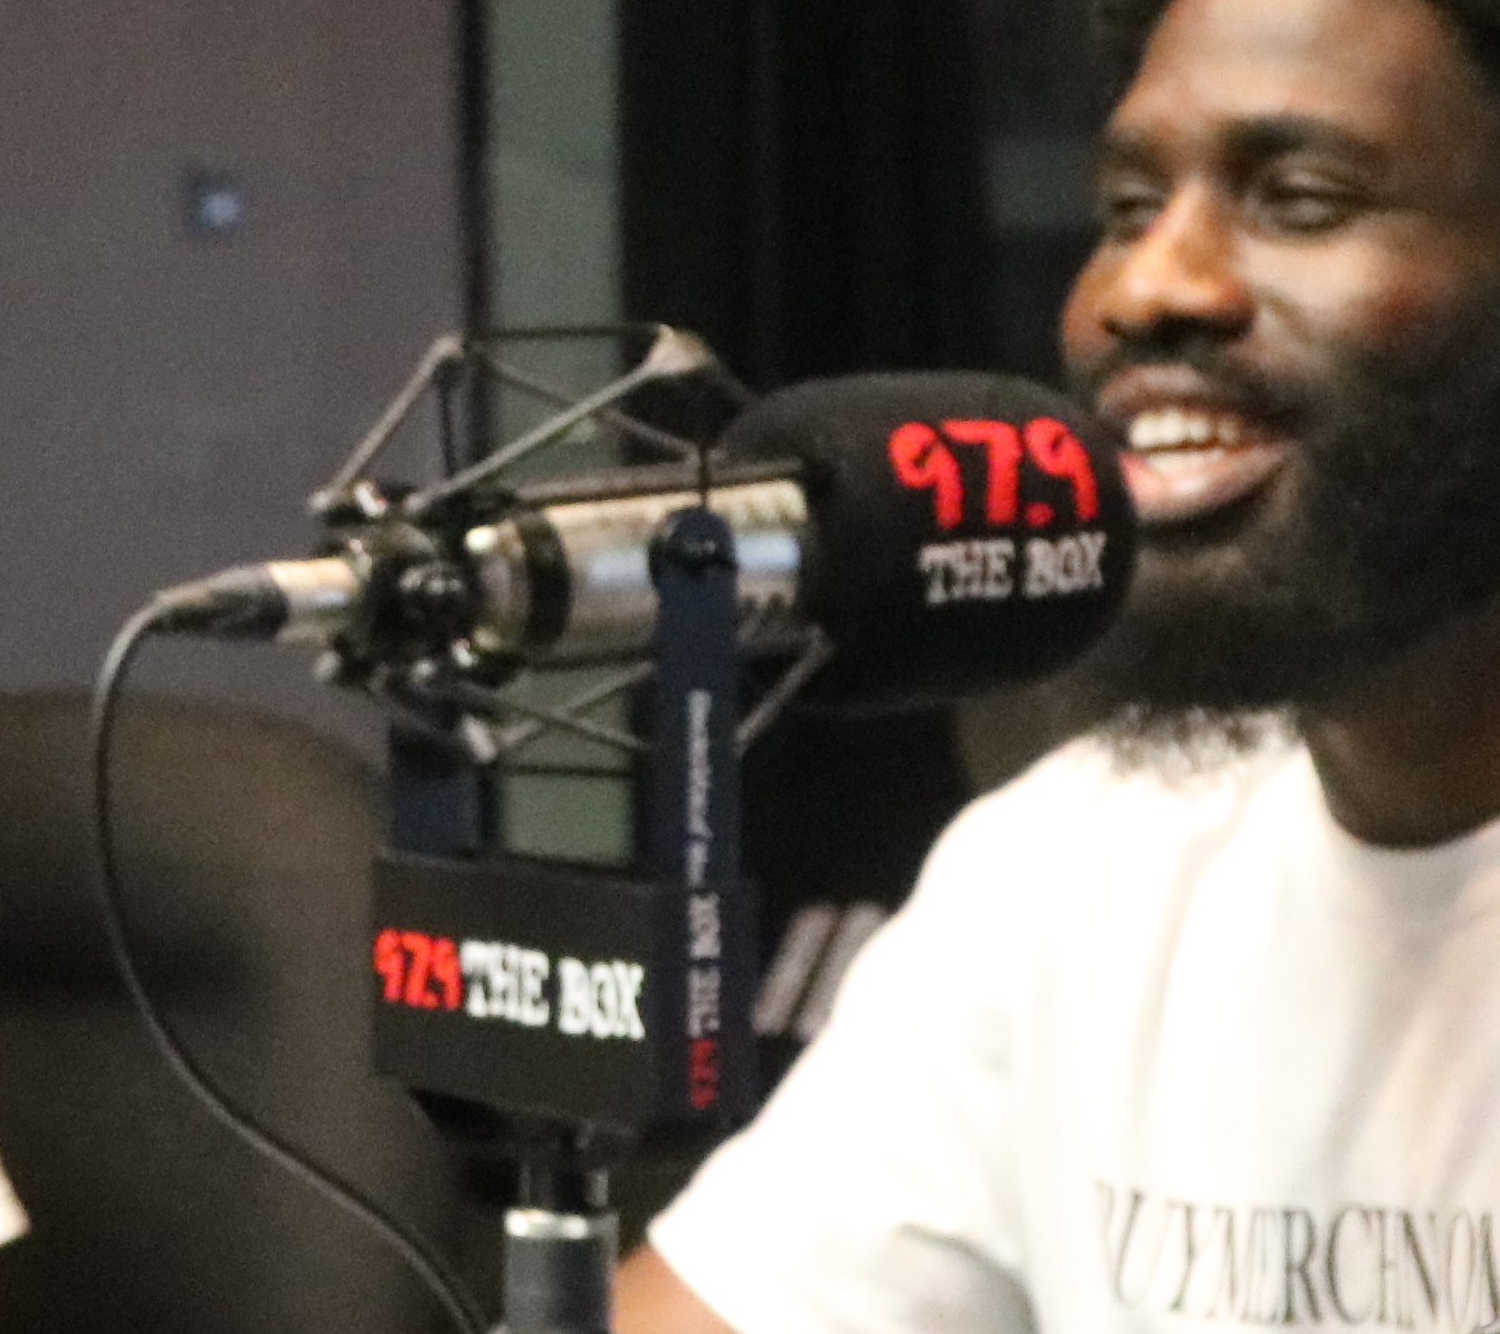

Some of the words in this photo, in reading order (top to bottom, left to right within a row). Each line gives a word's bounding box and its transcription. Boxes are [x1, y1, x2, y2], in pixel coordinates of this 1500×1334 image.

[888, 417, 1098, 530] 97.9
[917, 538, 1015, 607] THE
[1023, 531, 1107, 599] BOX
[373, 927, 463, 1011] 97.9
[461, 939, 549, 1027] THE
[558, 956, 646, 1041] BOX
